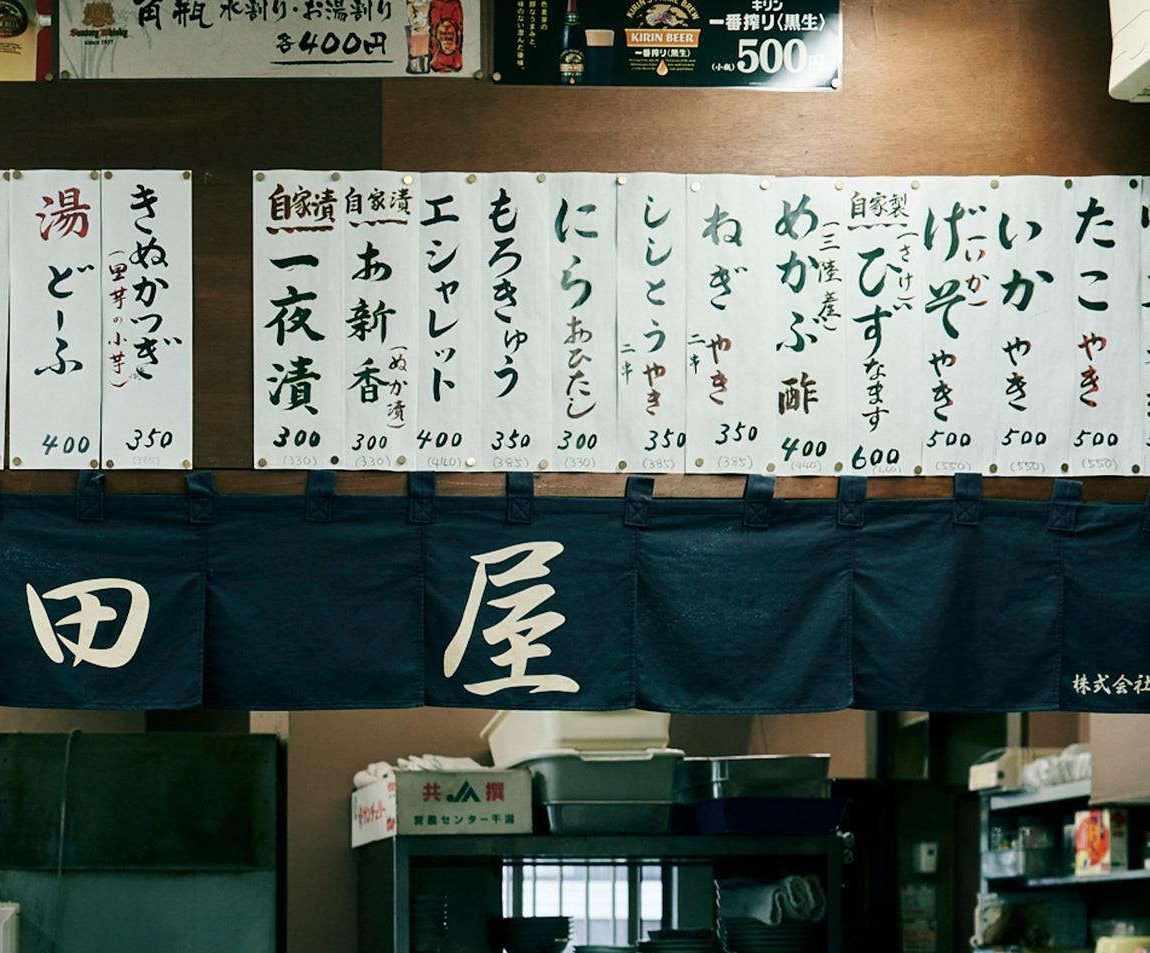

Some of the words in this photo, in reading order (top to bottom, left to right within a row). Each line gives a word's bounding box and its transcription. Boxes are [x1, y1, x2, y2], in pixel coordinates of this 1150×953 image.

[276, 31, 388, 55] 各400円
[631, 32, 663, 42] KIRIN
[666, 32, 694, 43] BEER
[737, 38, 824, 74] 500
[850, 191, 910, 220] 自家製
[129, 184, 182, 380] きぬかつぎ
[488, 188, 529, 398] もろきゅう
[420, 195, 460, 402] エシャレット
[263, 253, 326, 416] 一夜漬
[42, 434, 90, 455] 400
[125, 428, 173, 451] 350
[273, 427, 321, 448] 300
[351, 433, 388, 451] 300
[416, 429, 462, 450] 400
[491, 428, 531, 450] 350
[557, 430, 598, 451] 300
[644, 428, 687, 452] 350
[715, 421, 758, 445] 350
[926, 431, 972, 448] 500
[1001, 428, 1047, 447] 500
[1073, 428, 1119, 447] 500
[780, 437, 827, 462] 400
[851, 445, 900, 470] 600
